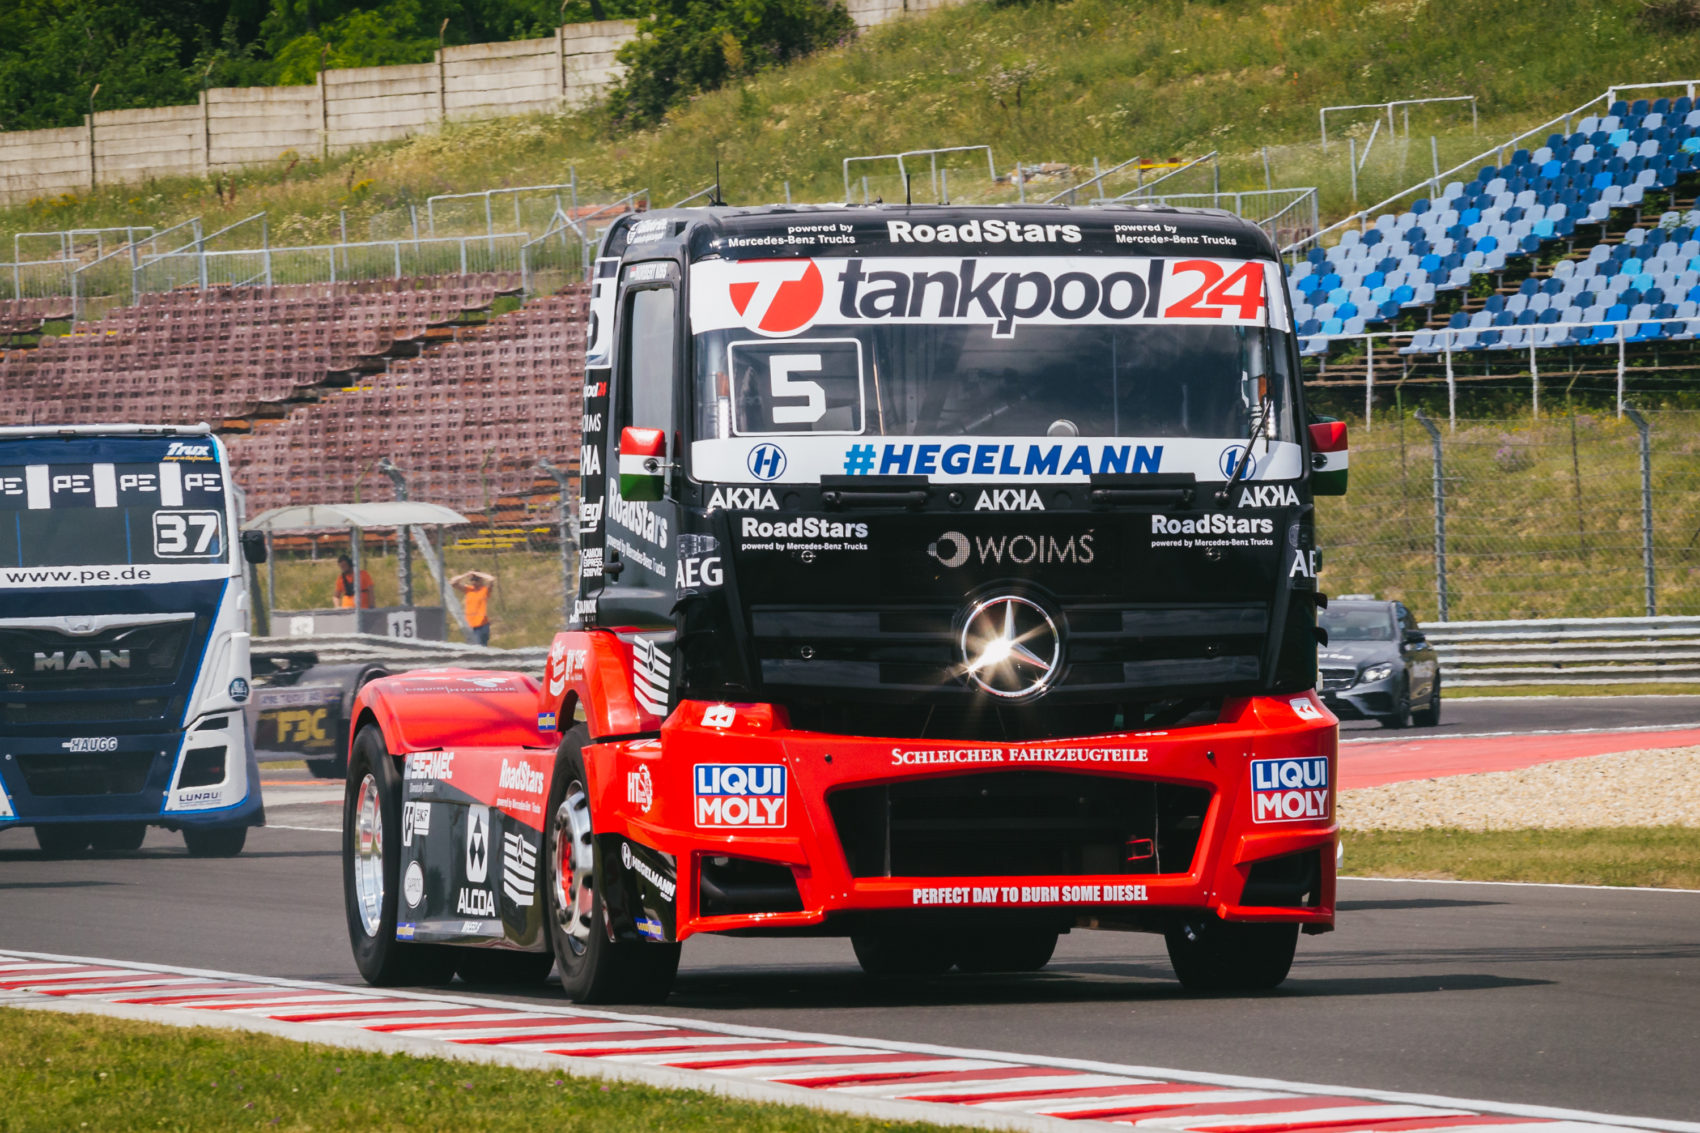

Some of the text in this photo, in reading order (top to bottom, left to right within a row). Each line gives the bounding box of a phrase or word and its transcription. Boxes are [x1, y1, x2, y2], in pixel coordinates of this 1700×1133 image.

[788, 224, 853, 234] powered by
[886, 220, 1082, 243] RoadStars
[1114, 224, 1177, 233] powered by
[1116, 234, 1237, 245] Mercedes-Benz Trucks
[728, 235, 856, 247] Mercedes-Benz Trucks
[838, 258, 1266, 335] tankpool24
[769, 354, 826, 424] 5
[166, 442, 210, 456] Trux
[843, 443, 1164, 477] #HEGELMANN
[0, 474, 222, 494] E PE PE PE
[708, 488, 780, 511] AKKA
[975, 488, 1045, 511] AKKA
[1238, 485, 1300, 508] AKKA
[608, 477, 669, 549] RoadStars
[1151, 514, 1274, 534] RoadStars
[156, 515, 217, 553] 37
[742, 517, 868, 538] RoadStars
[741, 542, 868, 551] powered by Mercedes-Benz Trucks
[1151, 538, 1274, 548] powered by Mercedes-Benz Trucks
[6, 567, 151, 583] www.pe.de
[675, 556, 724, 589] AEG
[393, 619, 413, 638] 15
[34, 649, 131, 671] MAN
[70, 737, 118, 752] HAUGG
[411, 751, 454, 780] SERMEC
[891, 748, 1148, 765] SCHLEICHER FAHRZEUGTEILE
[499, 758, 544, 794] RoadStars
[698, 767, 781, 796] LIQUI
[1256, 759, 1326, 790] LIQUI
[179, 791, 219, 802] LUNAU
[1256, 790, 1328, 820] MOLY
[698, 797, 784, 825] MOLY
[632, 855, 676, 897] HEGELMANN
[457, 887, 496, 918] ALCOA
[912, 885, 1148, 904] PERFECT DAY TO BURN SOME DIESEL
